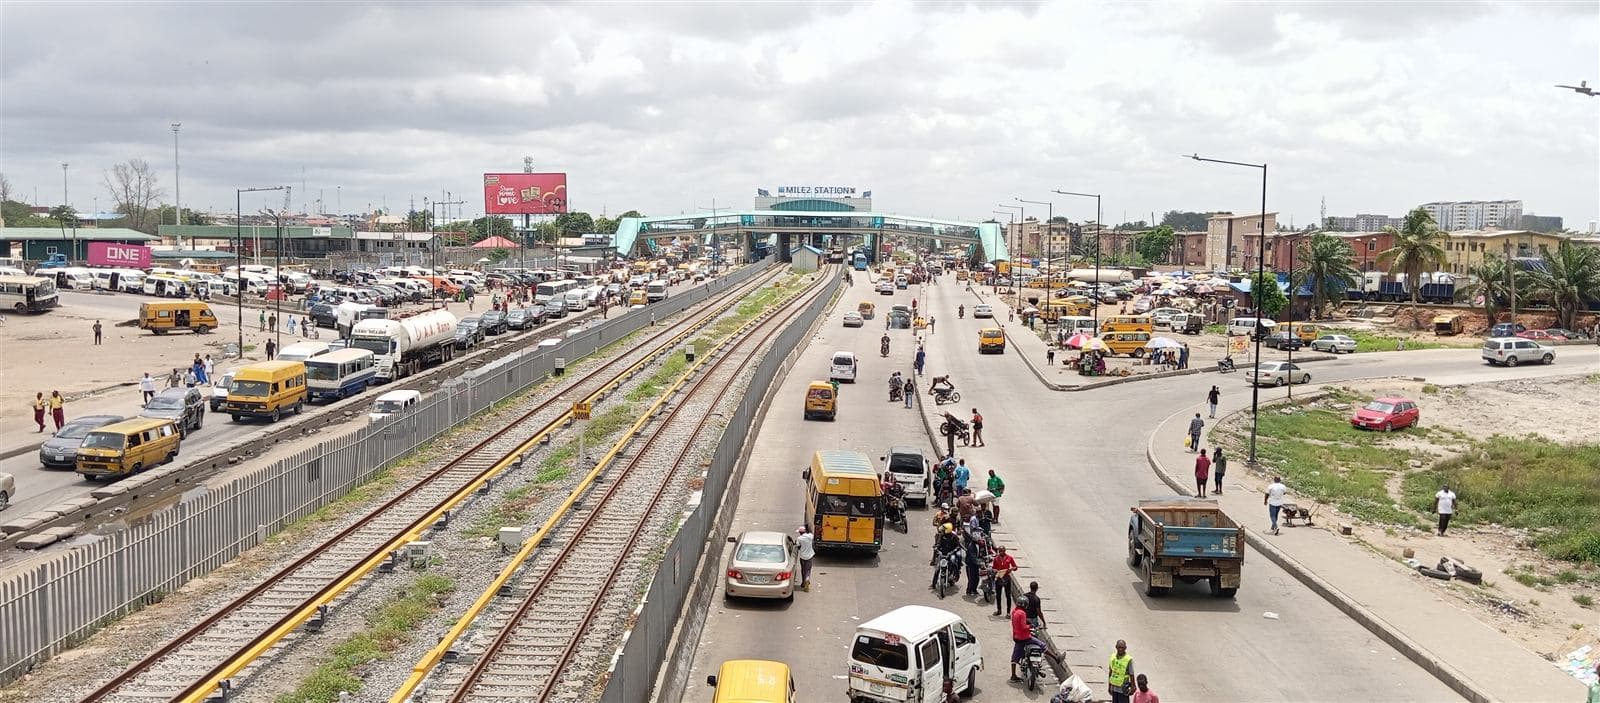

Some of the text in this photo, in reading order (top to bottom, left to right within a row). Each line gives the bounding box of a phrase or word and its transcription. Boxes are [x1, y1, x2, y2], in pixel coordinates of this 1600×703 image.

[786, 186, 849, 194] MILE2 STATION
[107, 246, 139, 260] ONE
